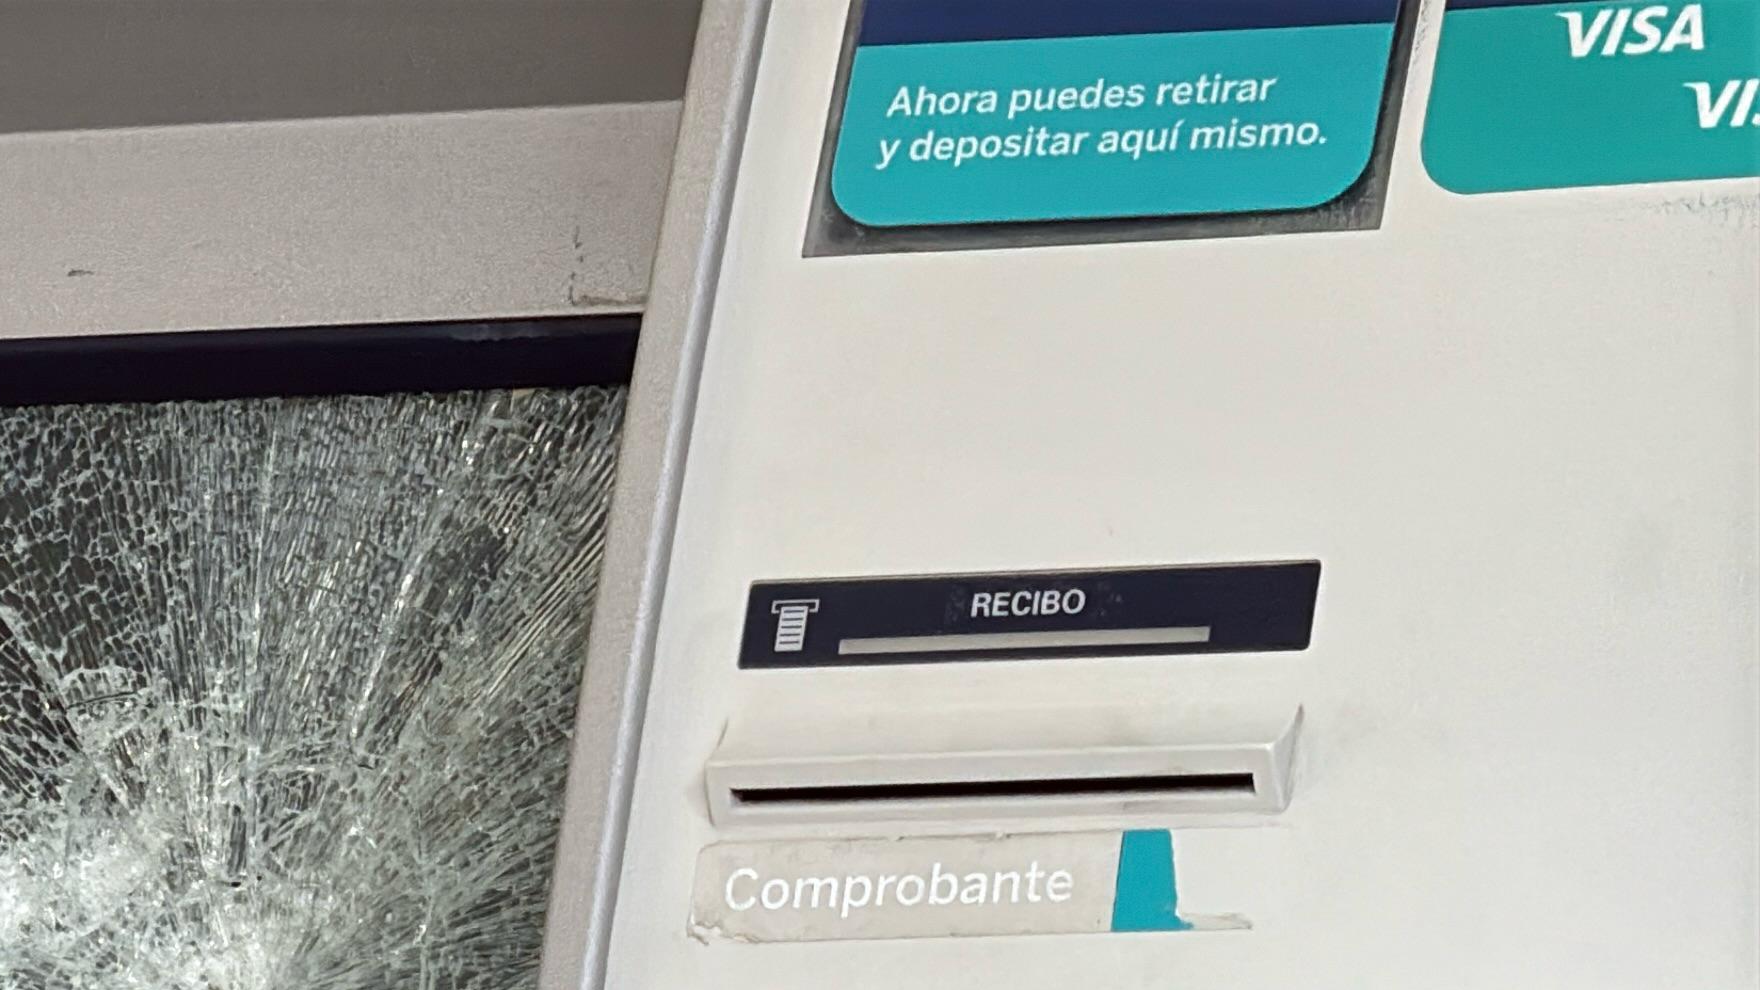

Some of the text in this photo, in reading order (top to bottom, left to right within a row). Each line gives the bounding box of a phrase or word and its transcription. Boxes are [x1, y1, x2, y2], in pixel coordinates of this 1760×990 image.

[1555, 4, 1705, 58] VISA
[886, 73, 1277, 119] Ahora puedes retirar
[1682, 78, 1760, 129] VI
[875, 118, 1328, 170] y depositar aquí mismo.
[970, 589, 1086, 618] RECIBO
[724, 860, 1074, 918] Comprobante
